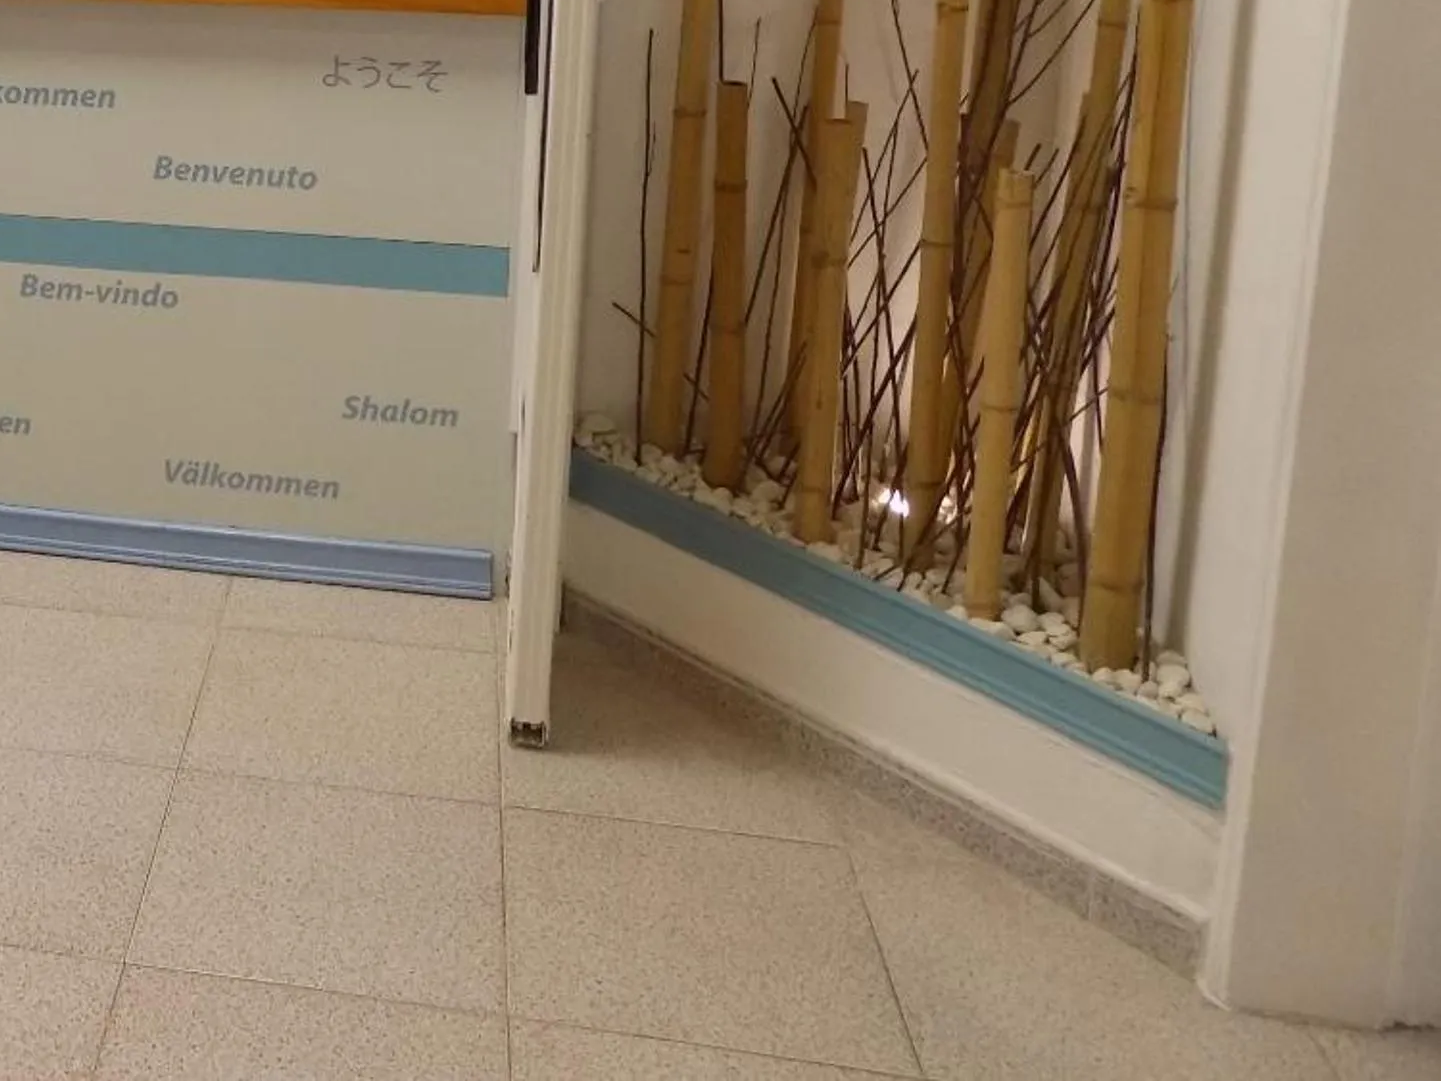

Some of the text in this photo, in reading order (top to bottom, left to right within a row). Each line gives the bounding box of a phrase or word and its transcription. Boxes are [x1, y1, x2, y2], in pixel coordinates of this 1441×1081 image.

[322, 54, 449, 93] ようこそ
[153, 155, 318, 191] Benvenuto
[19, 273, 180, 310] Bem-vindo
[342, 395, 458, 428] Shalom
[164, 459, 340, 500] Välkommen
